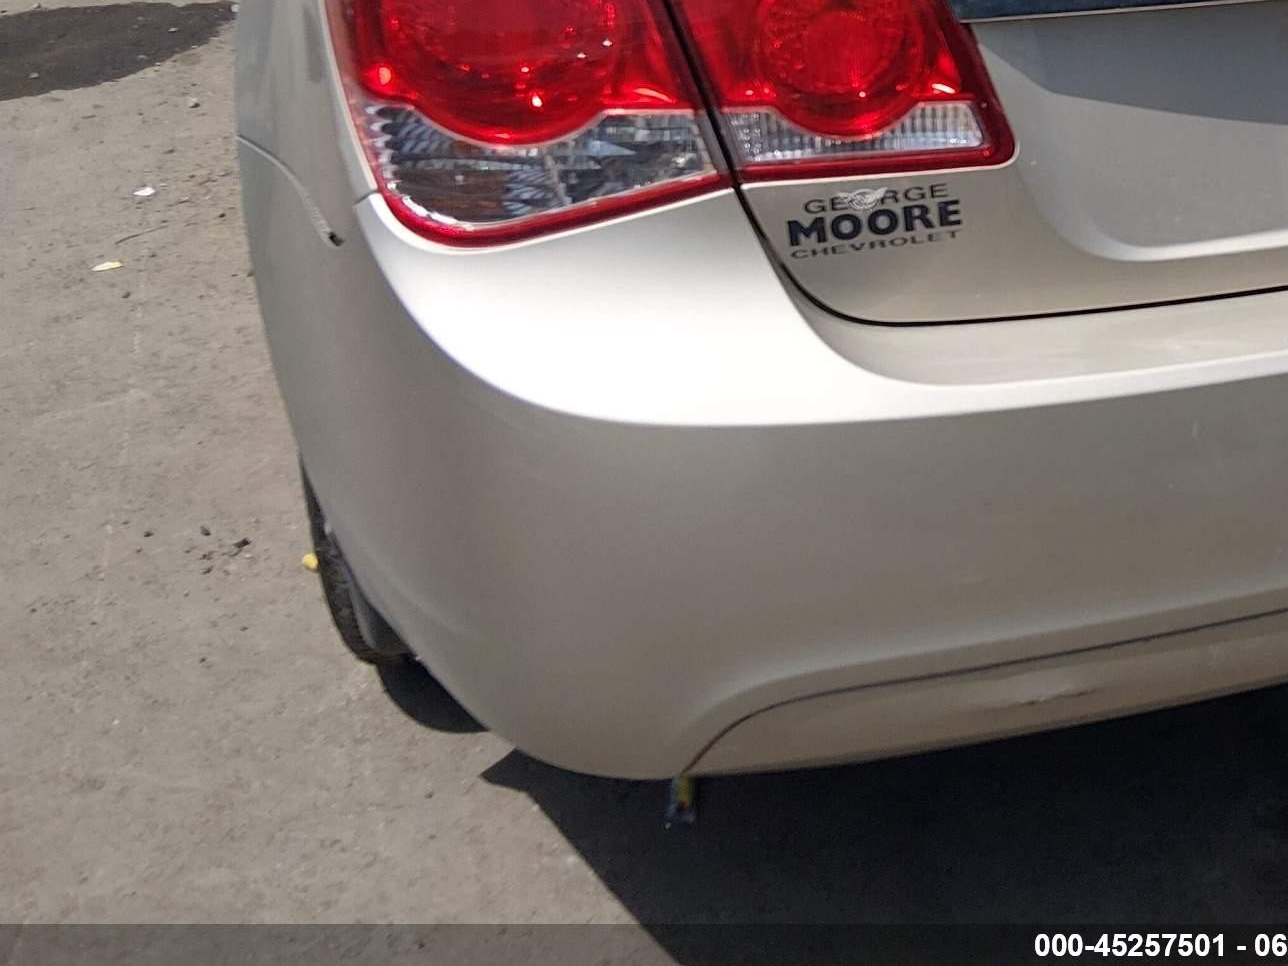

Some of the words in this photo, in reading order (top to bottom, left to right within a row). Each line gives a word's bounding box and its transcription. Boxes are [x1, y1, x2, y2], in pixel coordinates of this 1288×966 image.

[804, 183, 949, 215] GERGE
[787, 199, 963, 247] MOORE
[791, 229, 960, 260] CHEVROLET
